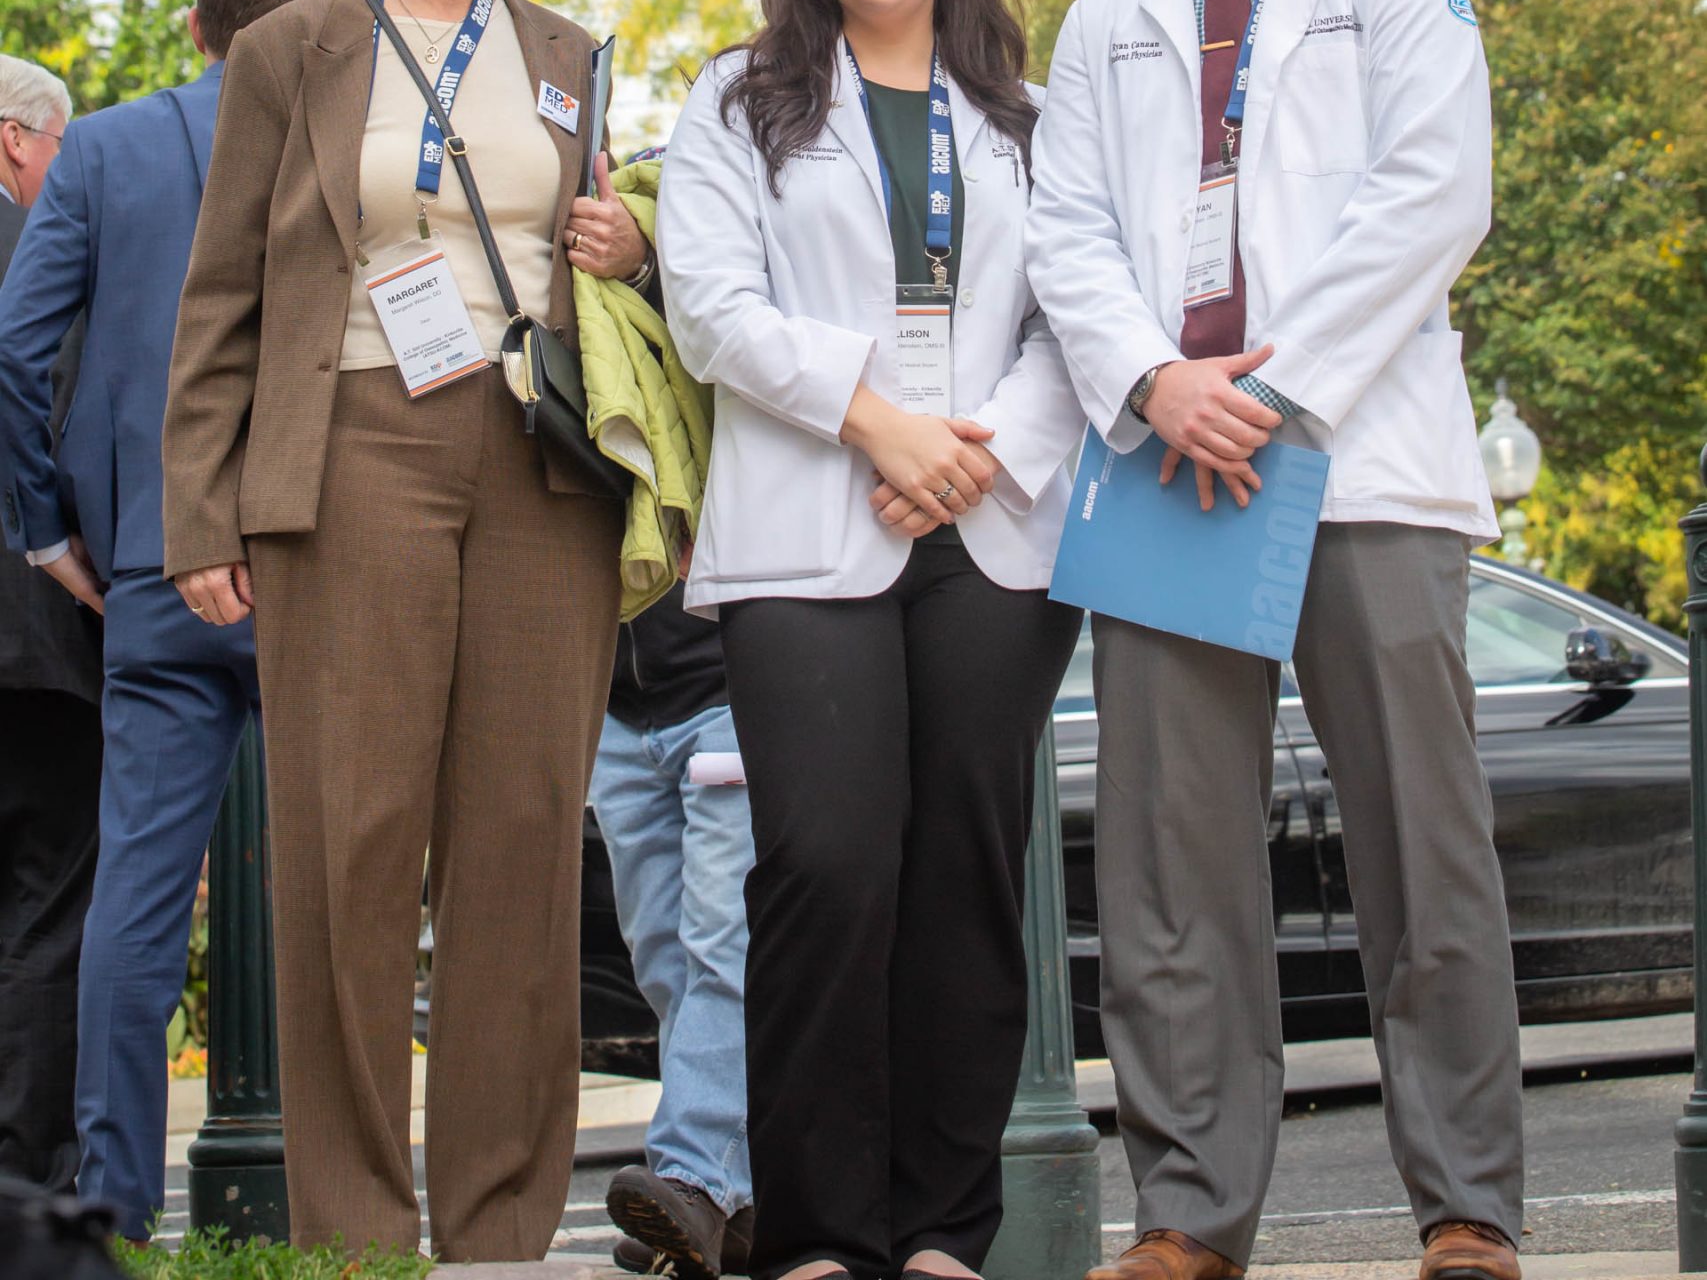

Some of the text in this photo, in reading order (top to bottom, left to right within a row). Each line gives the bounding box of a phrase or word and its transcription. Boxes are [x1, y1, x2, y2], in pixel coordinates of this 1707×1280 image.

[1131, 50, 1163, 61] Physician
[546, 86, 564, 102] ED
[544, 96, 568, 113] MED
[433, 145, 443, 164] MED
[806, 153, 837, 162] Physician
[931, 134, 951, 174] aacom
[931, 198, 942, 214] ED
[941, 195, 951, 215] MED
[1196, 202, 1212, 213] YAN
[387, 276, 440, 305] MARGARET
[896, 329, 930, 338] LISON
[1082, 481, 1099, 520] aacom
[1245, 444, 1330, 660] aacom
